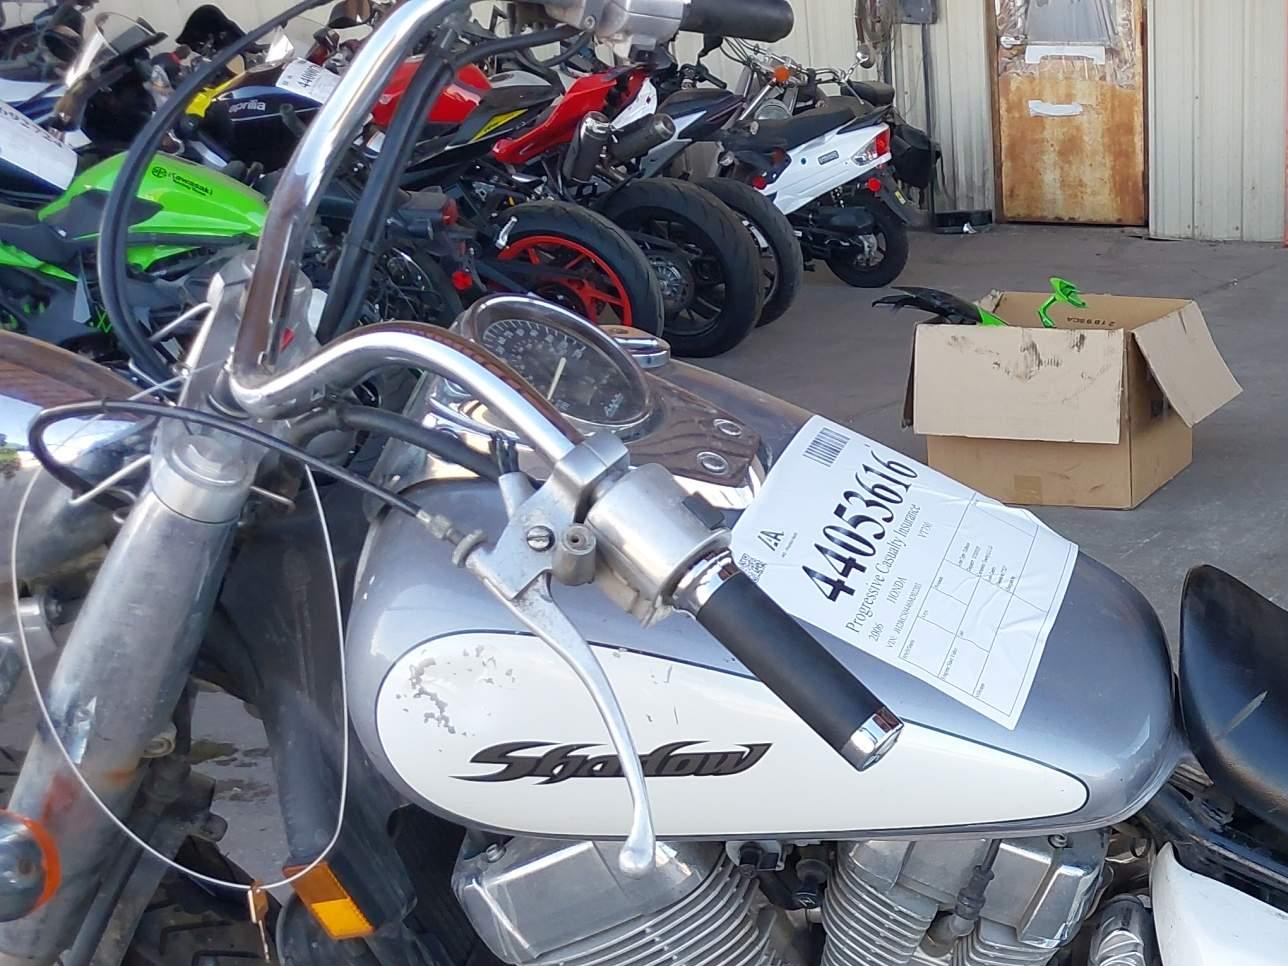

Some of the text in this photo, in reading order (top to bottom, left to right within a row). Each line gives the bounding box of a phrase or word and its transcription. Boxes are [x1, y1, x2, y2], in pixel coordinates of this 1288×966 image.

[228, 99, 266, 112] aprilia
[801, 450, 918, 602] 44053616
[845, 503, 921, 633] Progressive Casualty Insurance
[868, 622, 885, 642] 2006
[886, 576, 907, 604] HONDA
[448, 740, 774, 785] Shadow
